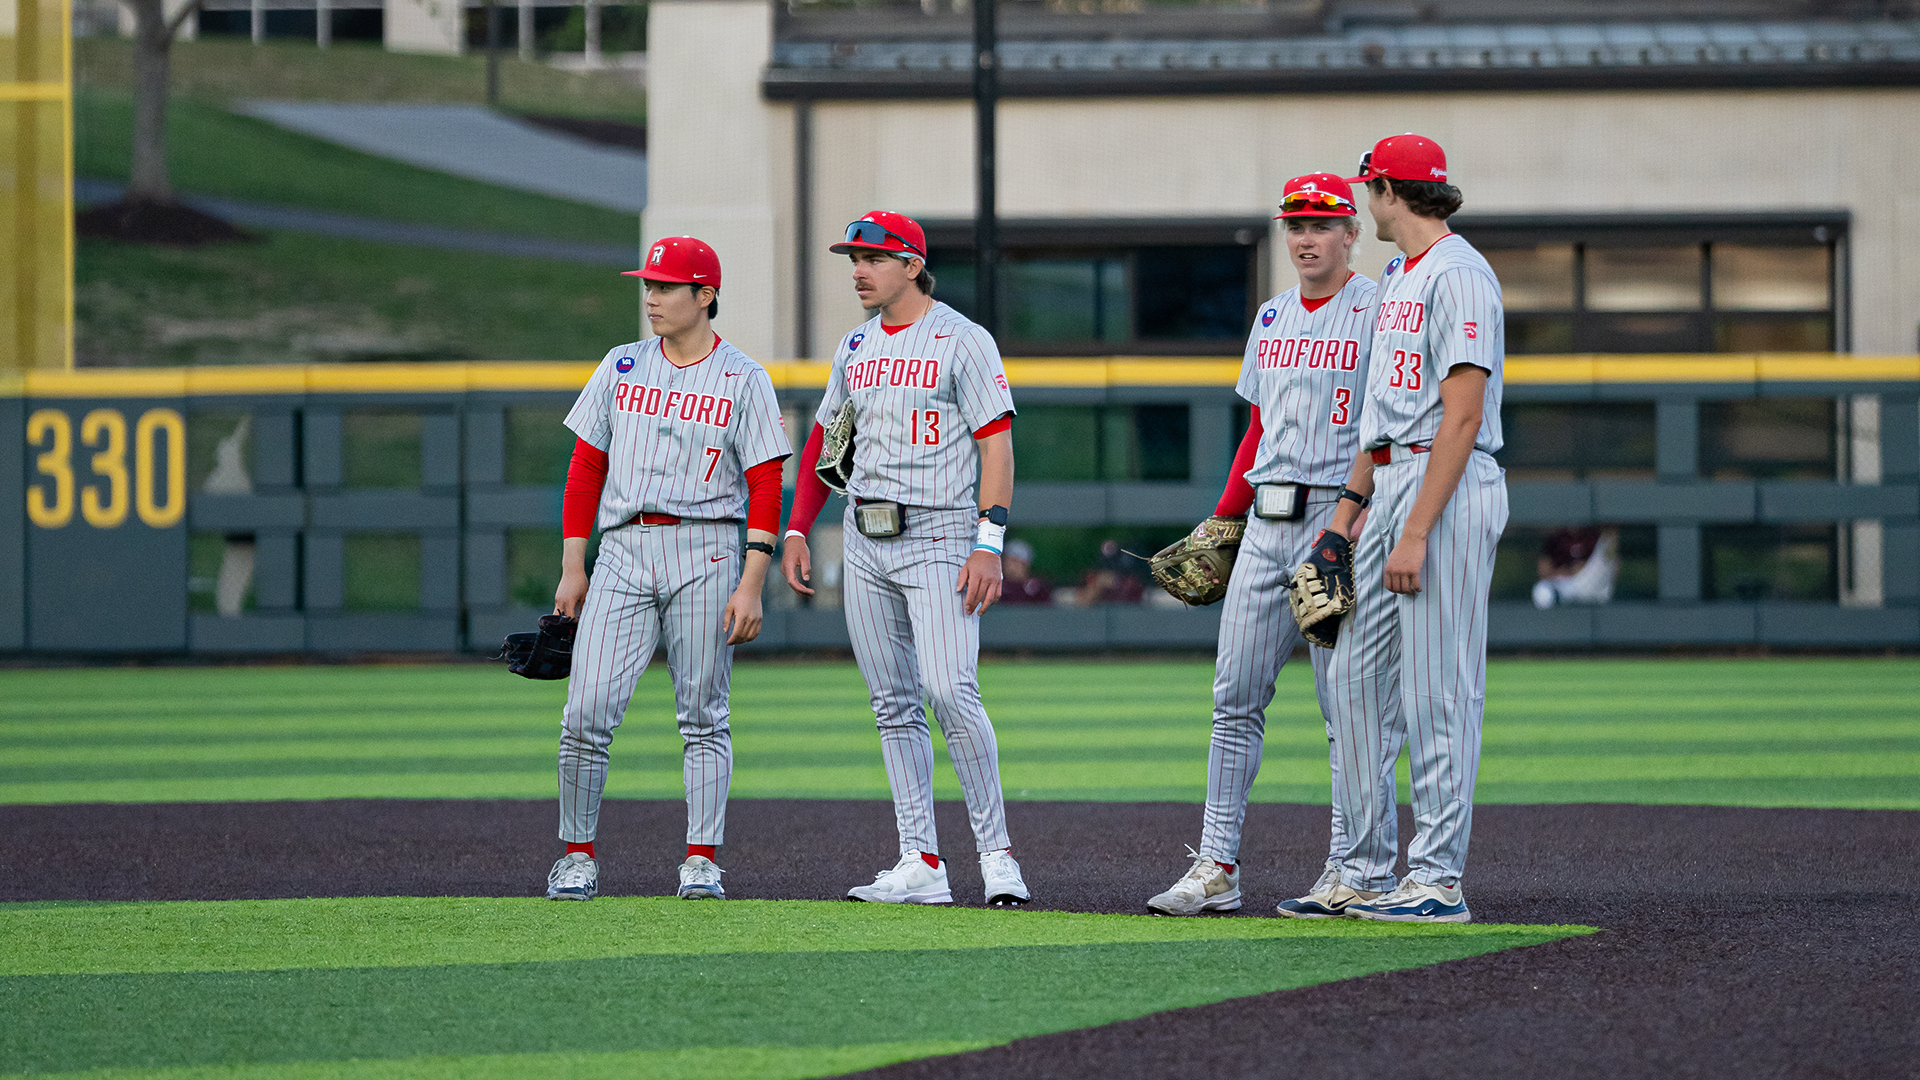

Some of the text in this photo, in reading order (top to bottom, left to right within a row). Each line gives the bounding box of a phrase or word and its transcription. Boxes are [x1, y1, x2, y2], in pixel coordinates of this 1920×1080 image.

[651, 245, 665, 265] R
[1258, 338, 1359, 372] RADFORD
[1389, 349, 1422, 391] 33
[847, 357, 941, 393] RADFORD
[616, 382, 733, 429] RADFORD
[1331, 387, 1351, 426] 3
[910, 408, 940, 446] 13
[26, 408, 186, 529] 330
[703, 446, 723, 484] 7
